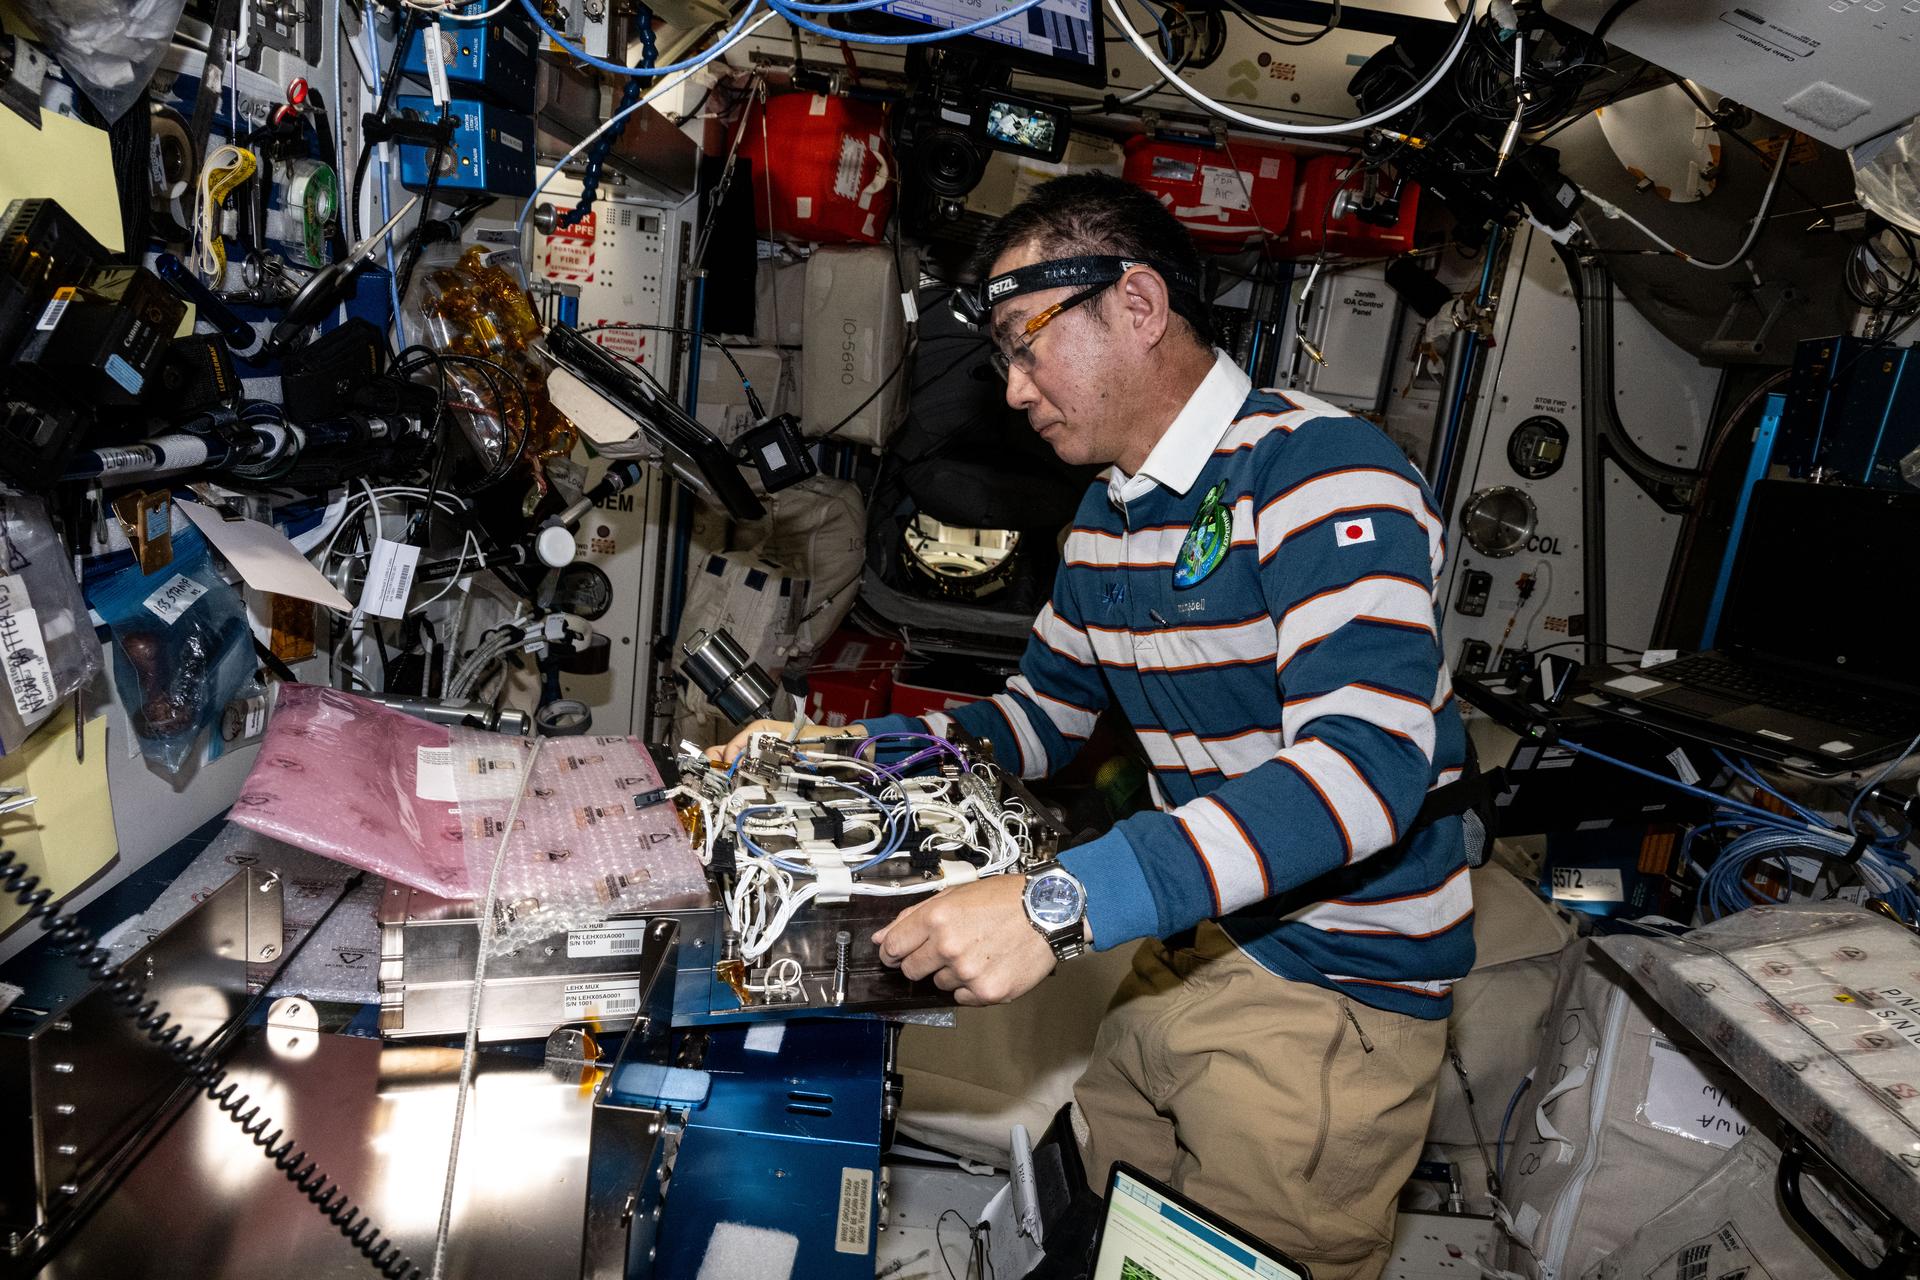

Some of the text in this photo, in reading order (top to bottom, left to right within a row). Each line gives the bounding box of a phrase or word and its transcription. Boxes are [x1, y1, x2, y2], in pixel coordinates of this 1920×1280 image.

[575, 225, 595, 236] PFE
[554, 246, 587, 255] PORTABLE
[560, 256, 580, 265] FIRE
[988, 278, 1018, 299] PETZL
[1044, 266, 1087, 279] TIKKA
[1344, 297, 1384, 309] IDA Control
[1354, 289, 1377, 299] Zenith
[1352, 307, 1372, 317] Panel
[123, 320, 142, 347] Canon
[605, 336, 638, 345] BREATHING
[608, 329, 634, 337] PORTABLE
[841, 318, 857, 386] 10-5690
[208, 345, 226, 394] LEATHERMAN
[1527, 535, 1562, 555] COL
[154, 576, 191, 615] ISS STAMP
[17, 674, 47, 714] NEW
[40, 671, 55, 701] Quantity
[1552, 868, 1583, 889] 5572
[578, 993, 621, 1001] LEHX05A0001
[1881, 987, 1911, 1010] P/N
[1876, 1009, 1911, 1034] S/N
[859, 1179, 868, 1210] HARDWARE
[840, 1178, 852, 1241] WRIST GROUND STRAP
[857, 1225, 865, 1243] USING
